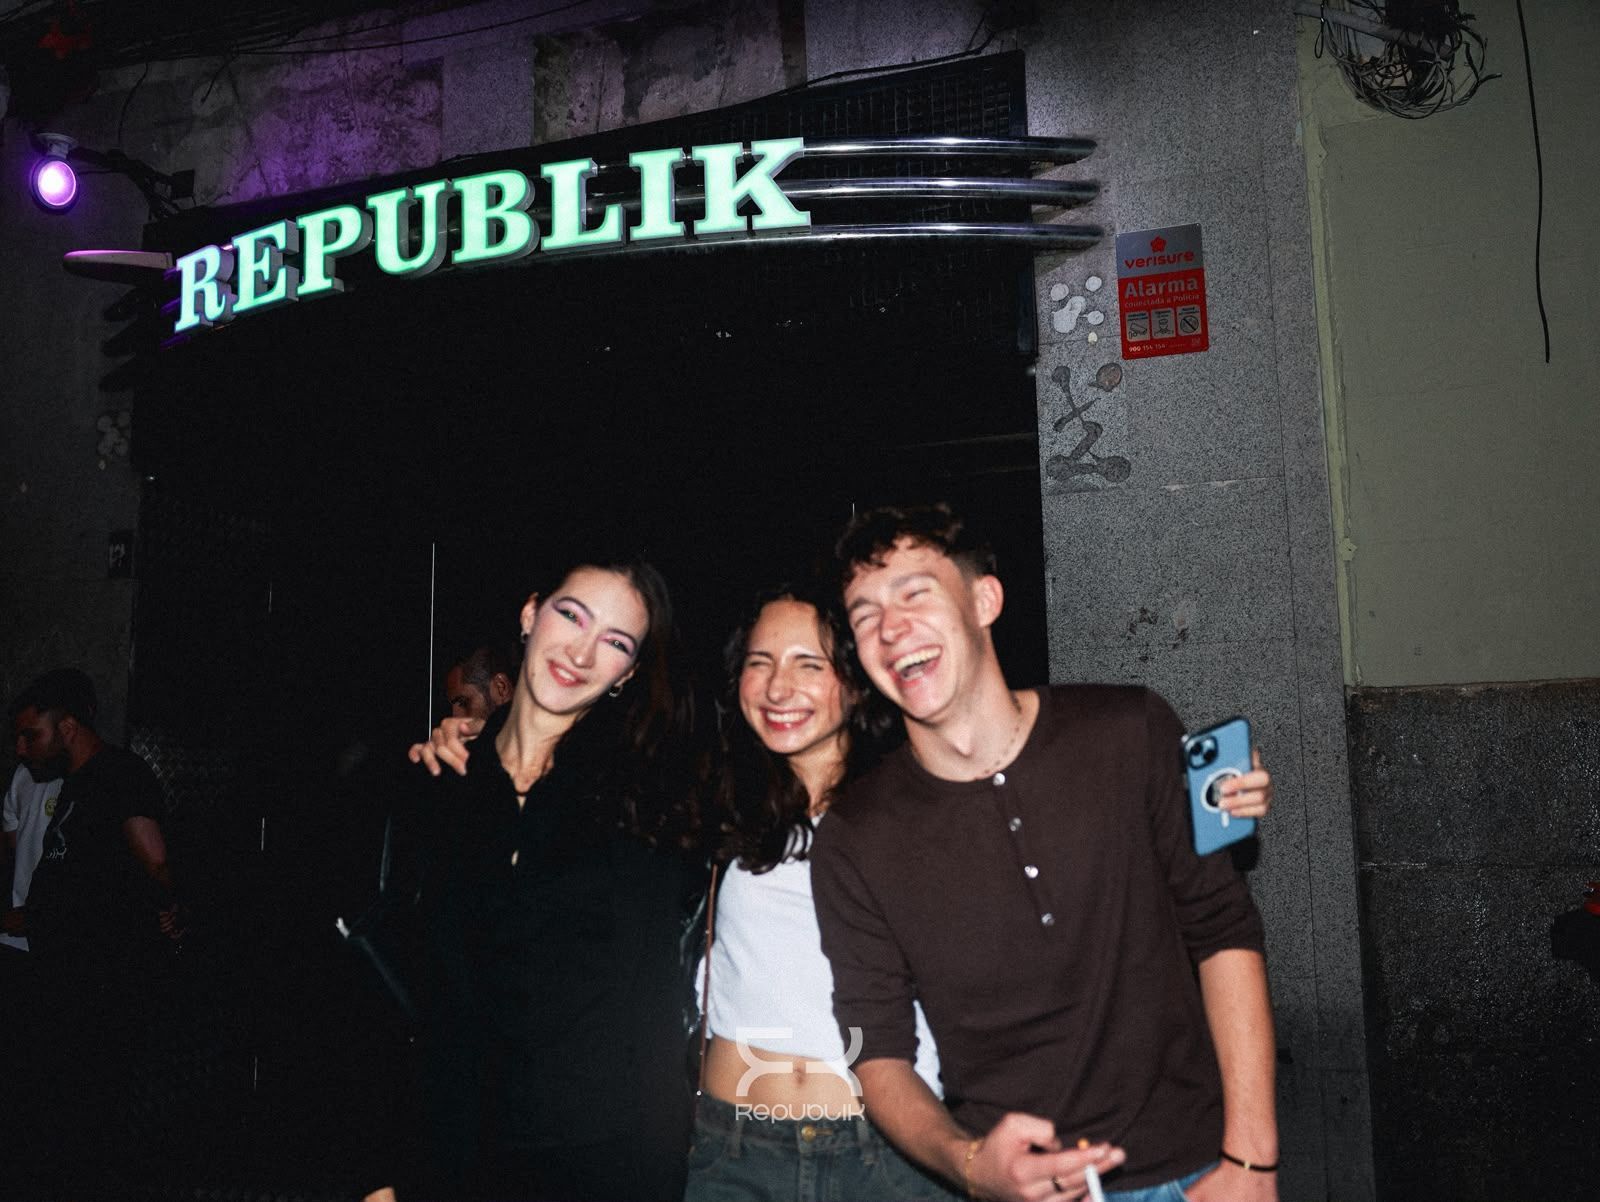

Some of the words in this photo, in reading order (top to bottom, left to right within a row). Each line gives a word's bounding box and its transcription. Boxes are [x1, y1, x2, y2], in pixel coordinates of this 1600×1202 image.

[174, 137, 812, 332] REPUBLIK
[1124, 251, 1195, 269] verisure
[1124, 277, 1198, 299] Alarma
